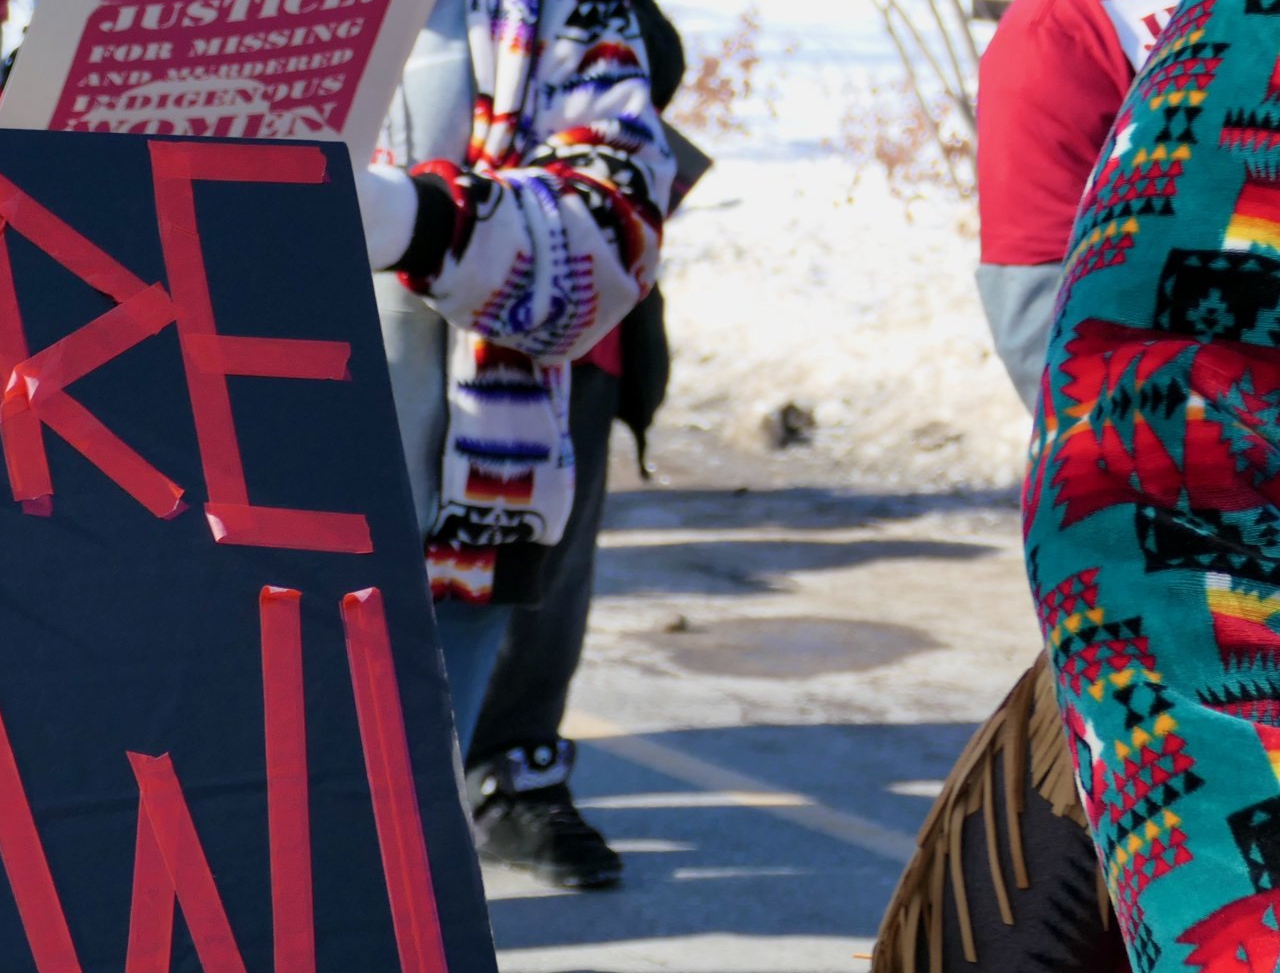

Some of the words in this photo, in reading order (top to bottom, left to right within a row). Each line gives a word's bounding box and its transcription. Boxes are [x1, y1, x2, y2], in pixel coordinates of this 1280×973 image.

[87, 41, 174, 64] FOR
[187, 16, 366, 58] MISSING
[72, 73, 346, 113] INDIGENOUS
[77, 70, 153, 87] AND
